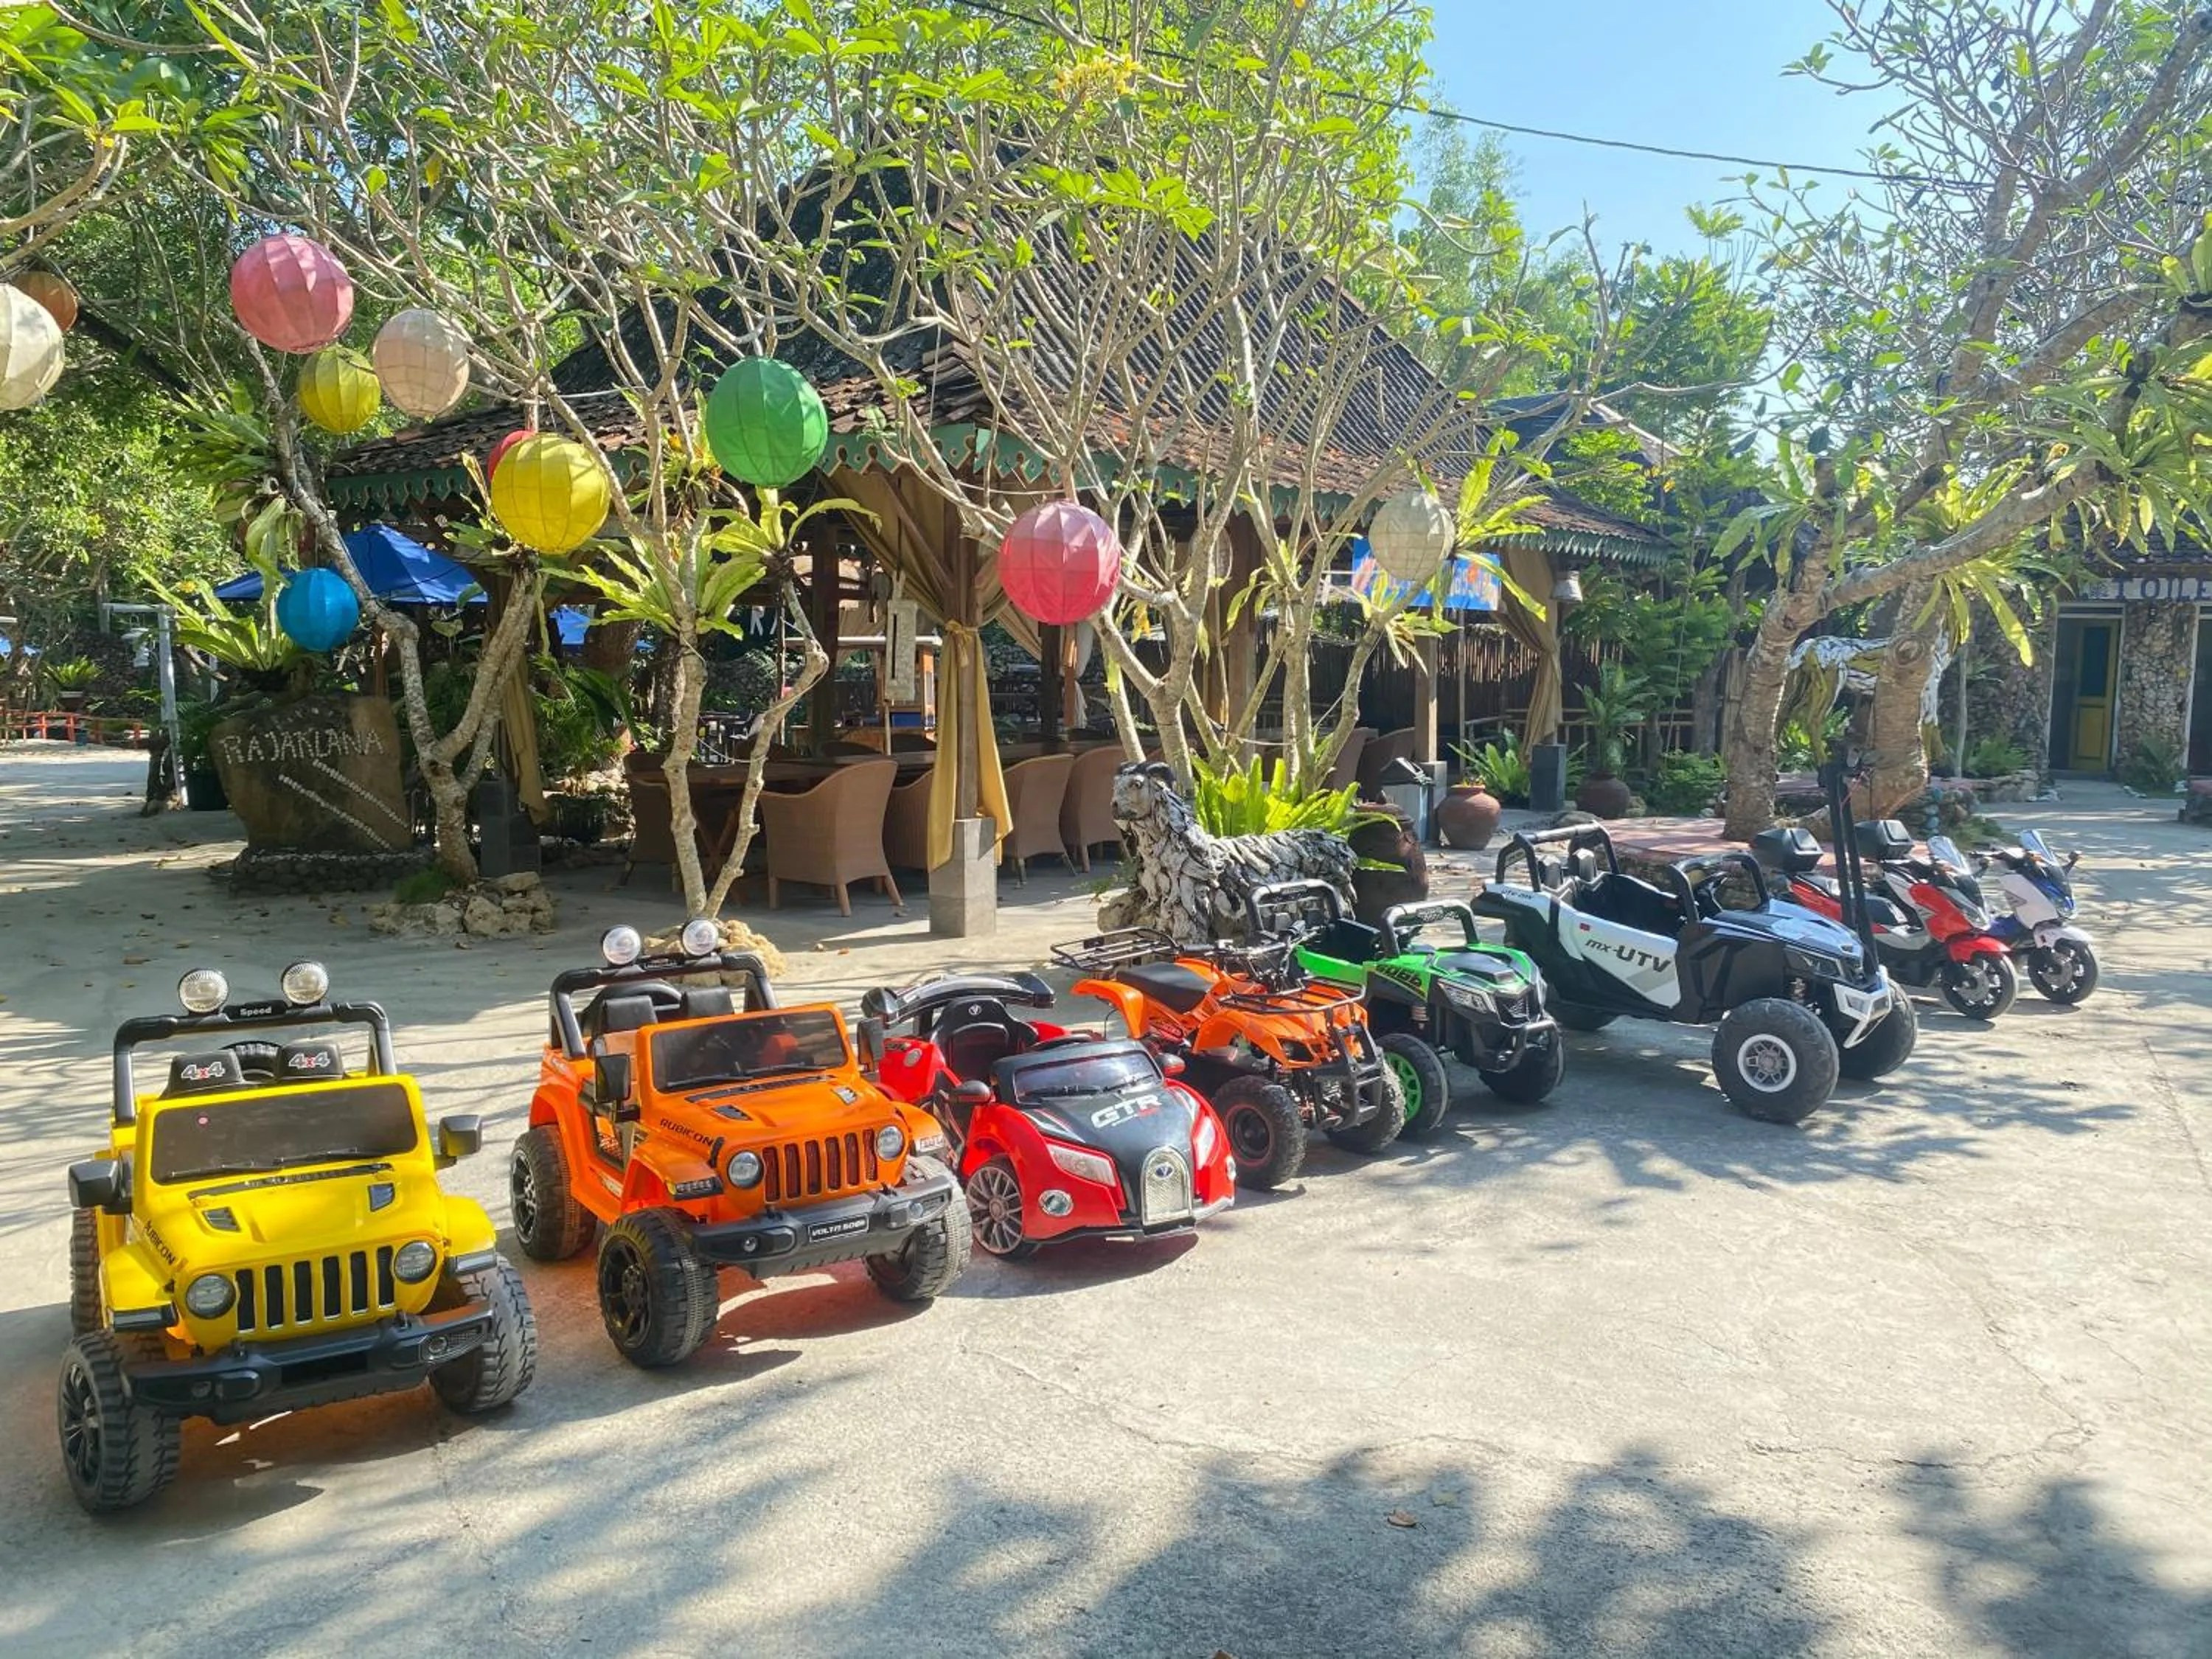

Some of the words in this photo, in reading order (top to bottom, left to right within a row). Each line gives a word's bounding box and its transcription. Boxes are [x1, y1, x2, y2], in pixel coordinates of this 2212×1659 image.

[240, 1006, 272, 1017] Speed
[288, 1051, 330, 1068] 4x4
[181, 1061, 226, 1080] 4x4
[1091, 1094, 1162, 1128] GTR
[660, 1118, 714, 1147] RUBICON
